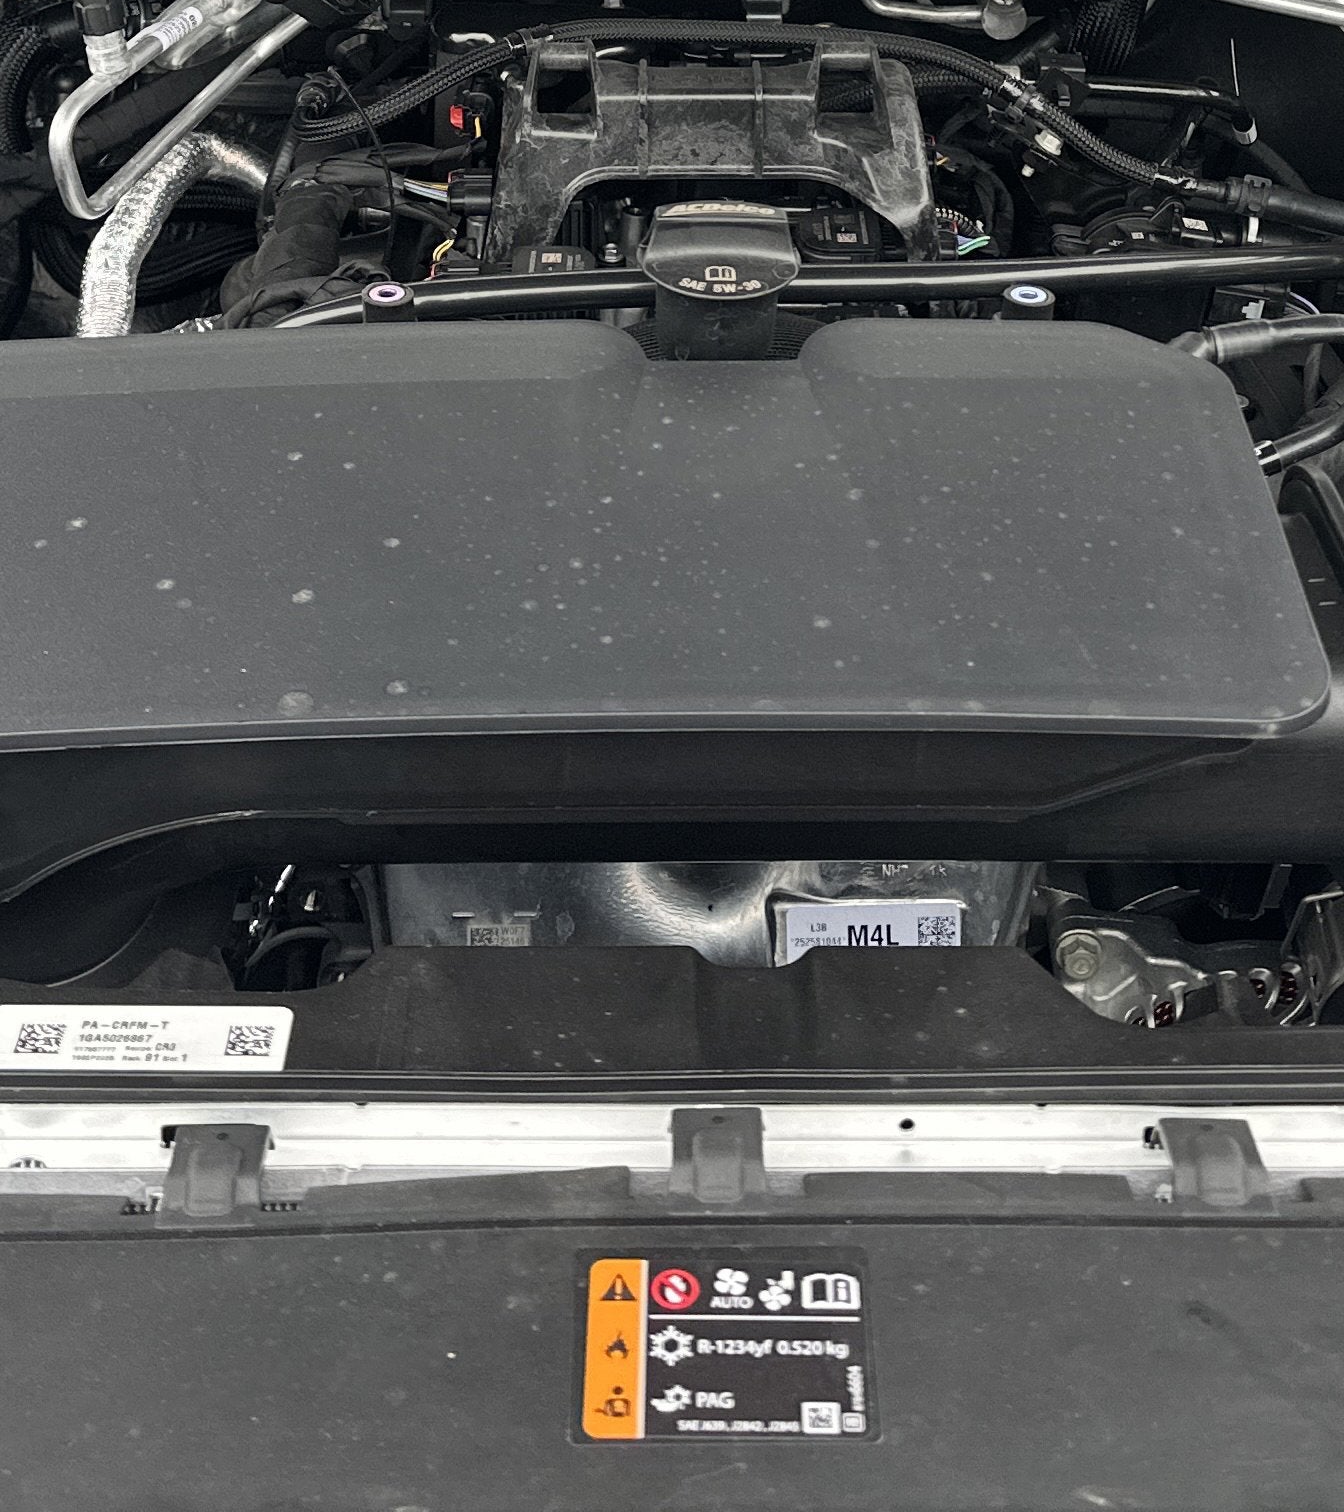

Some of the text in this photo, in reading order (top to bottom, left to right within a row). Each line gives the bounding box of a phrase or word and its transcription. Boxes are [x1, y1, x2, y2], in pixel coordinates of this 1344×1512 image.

[661, 203, 776, 217] ACDelco
[678, 277, 762, 294] SAE 5W-30
[847, 924, 899, 946] M4L
[710, 1296, 754, 1309] AUTO
[696, 1339, 850, 1359] R-1234yf 0.520 kg
[695, 1391, 736, 1409] PAG
[676, 1420, 699, 1431] SAE
